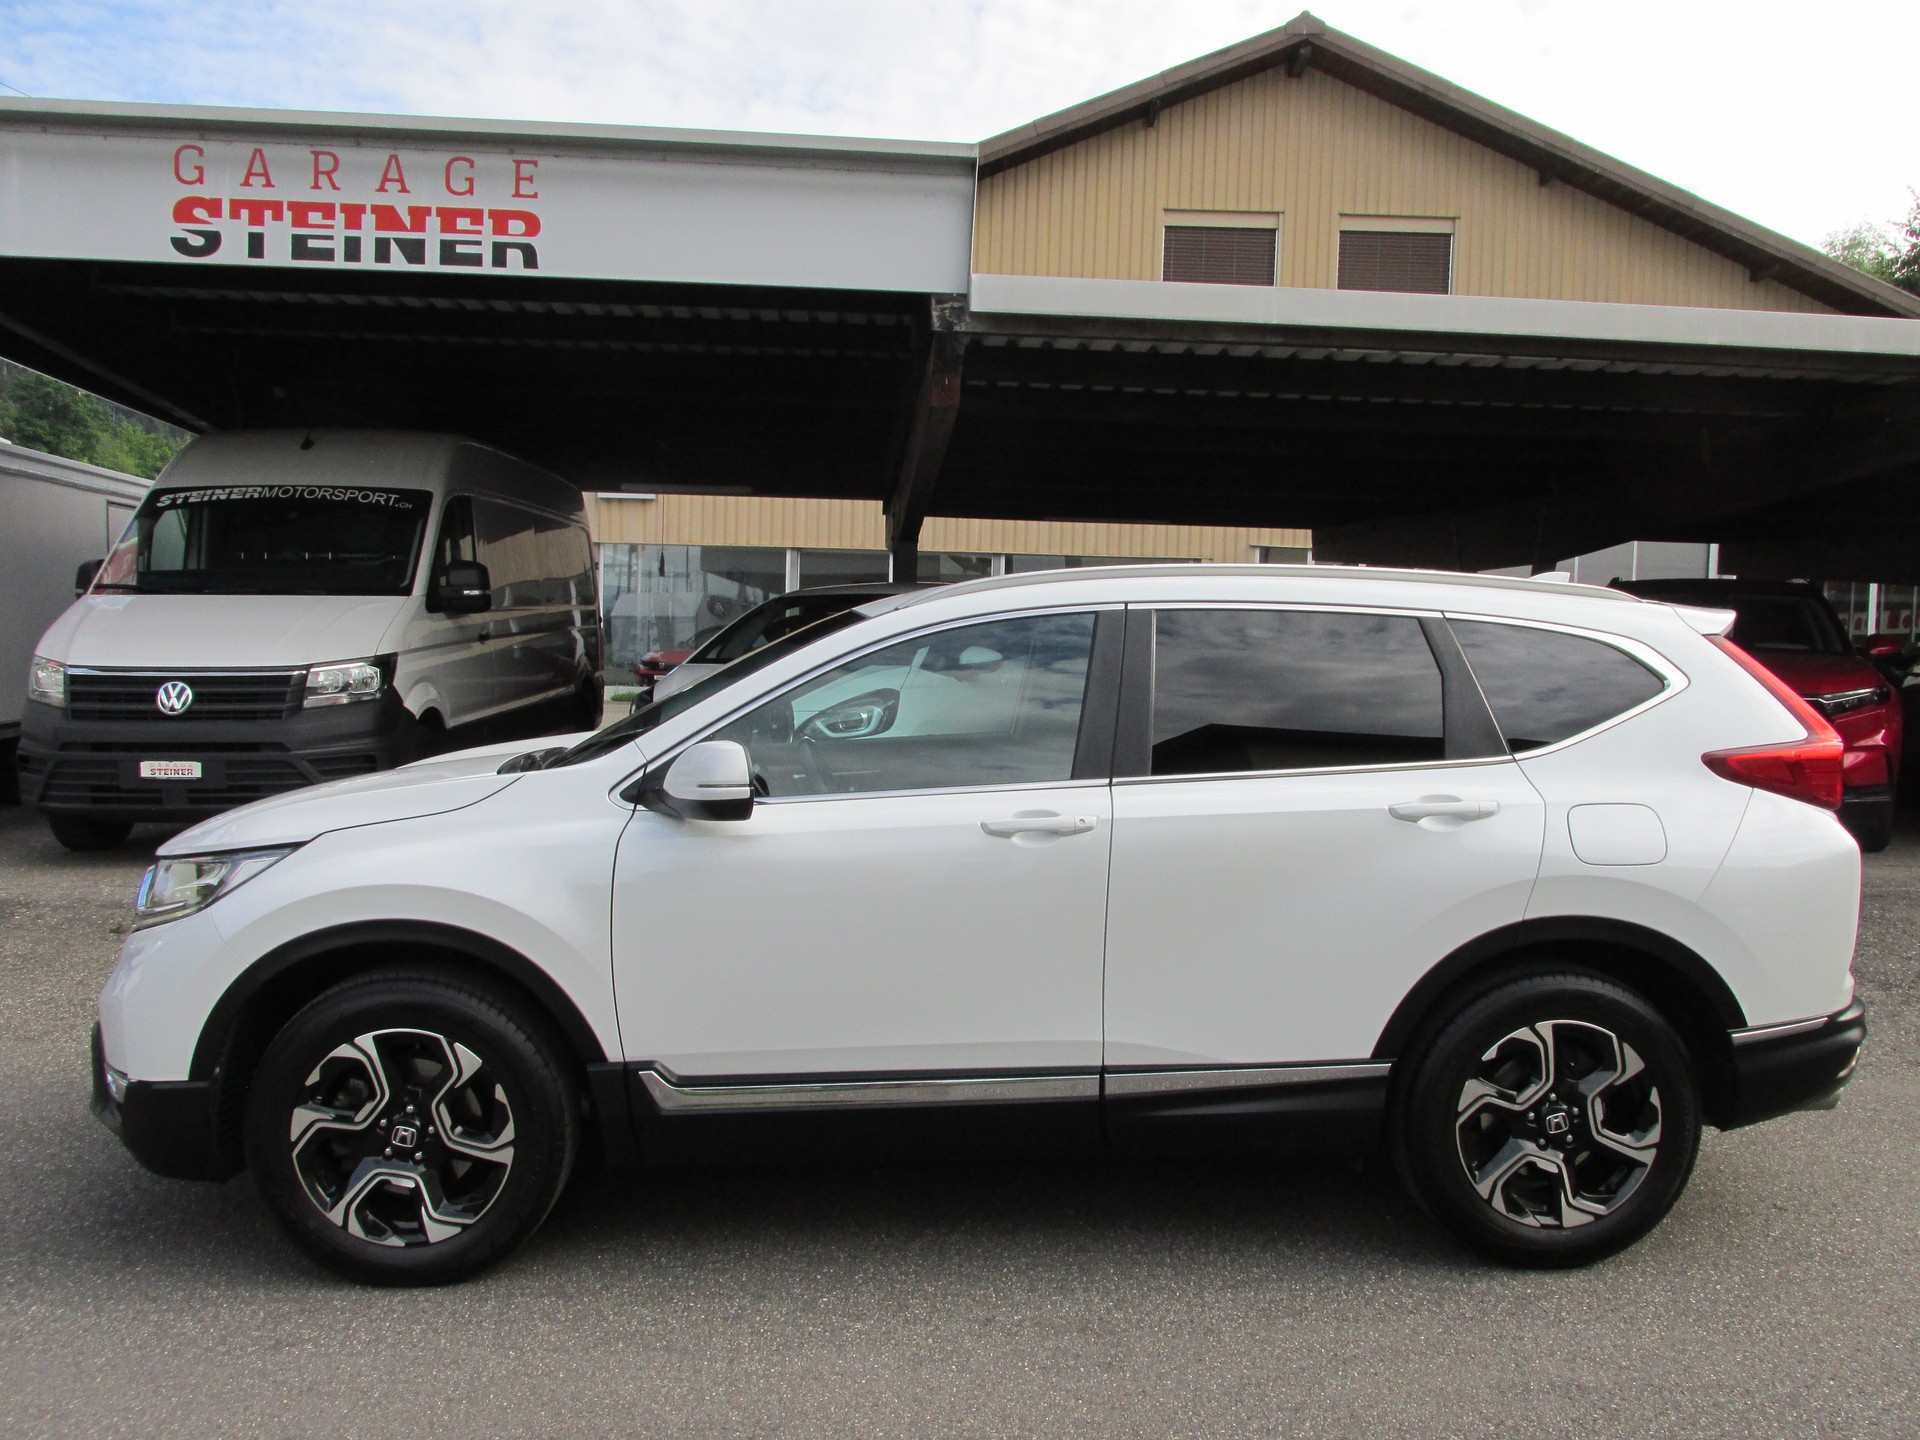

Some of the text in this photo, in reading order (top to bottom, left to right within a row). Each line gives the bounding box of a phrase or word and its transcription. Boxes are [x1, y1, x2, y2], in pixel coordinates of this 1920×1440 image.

[173, 144, 540, 199] GARAGE
[170, 195, 542, 269] STEINER
[150, 768, 193, 776] STEINER
